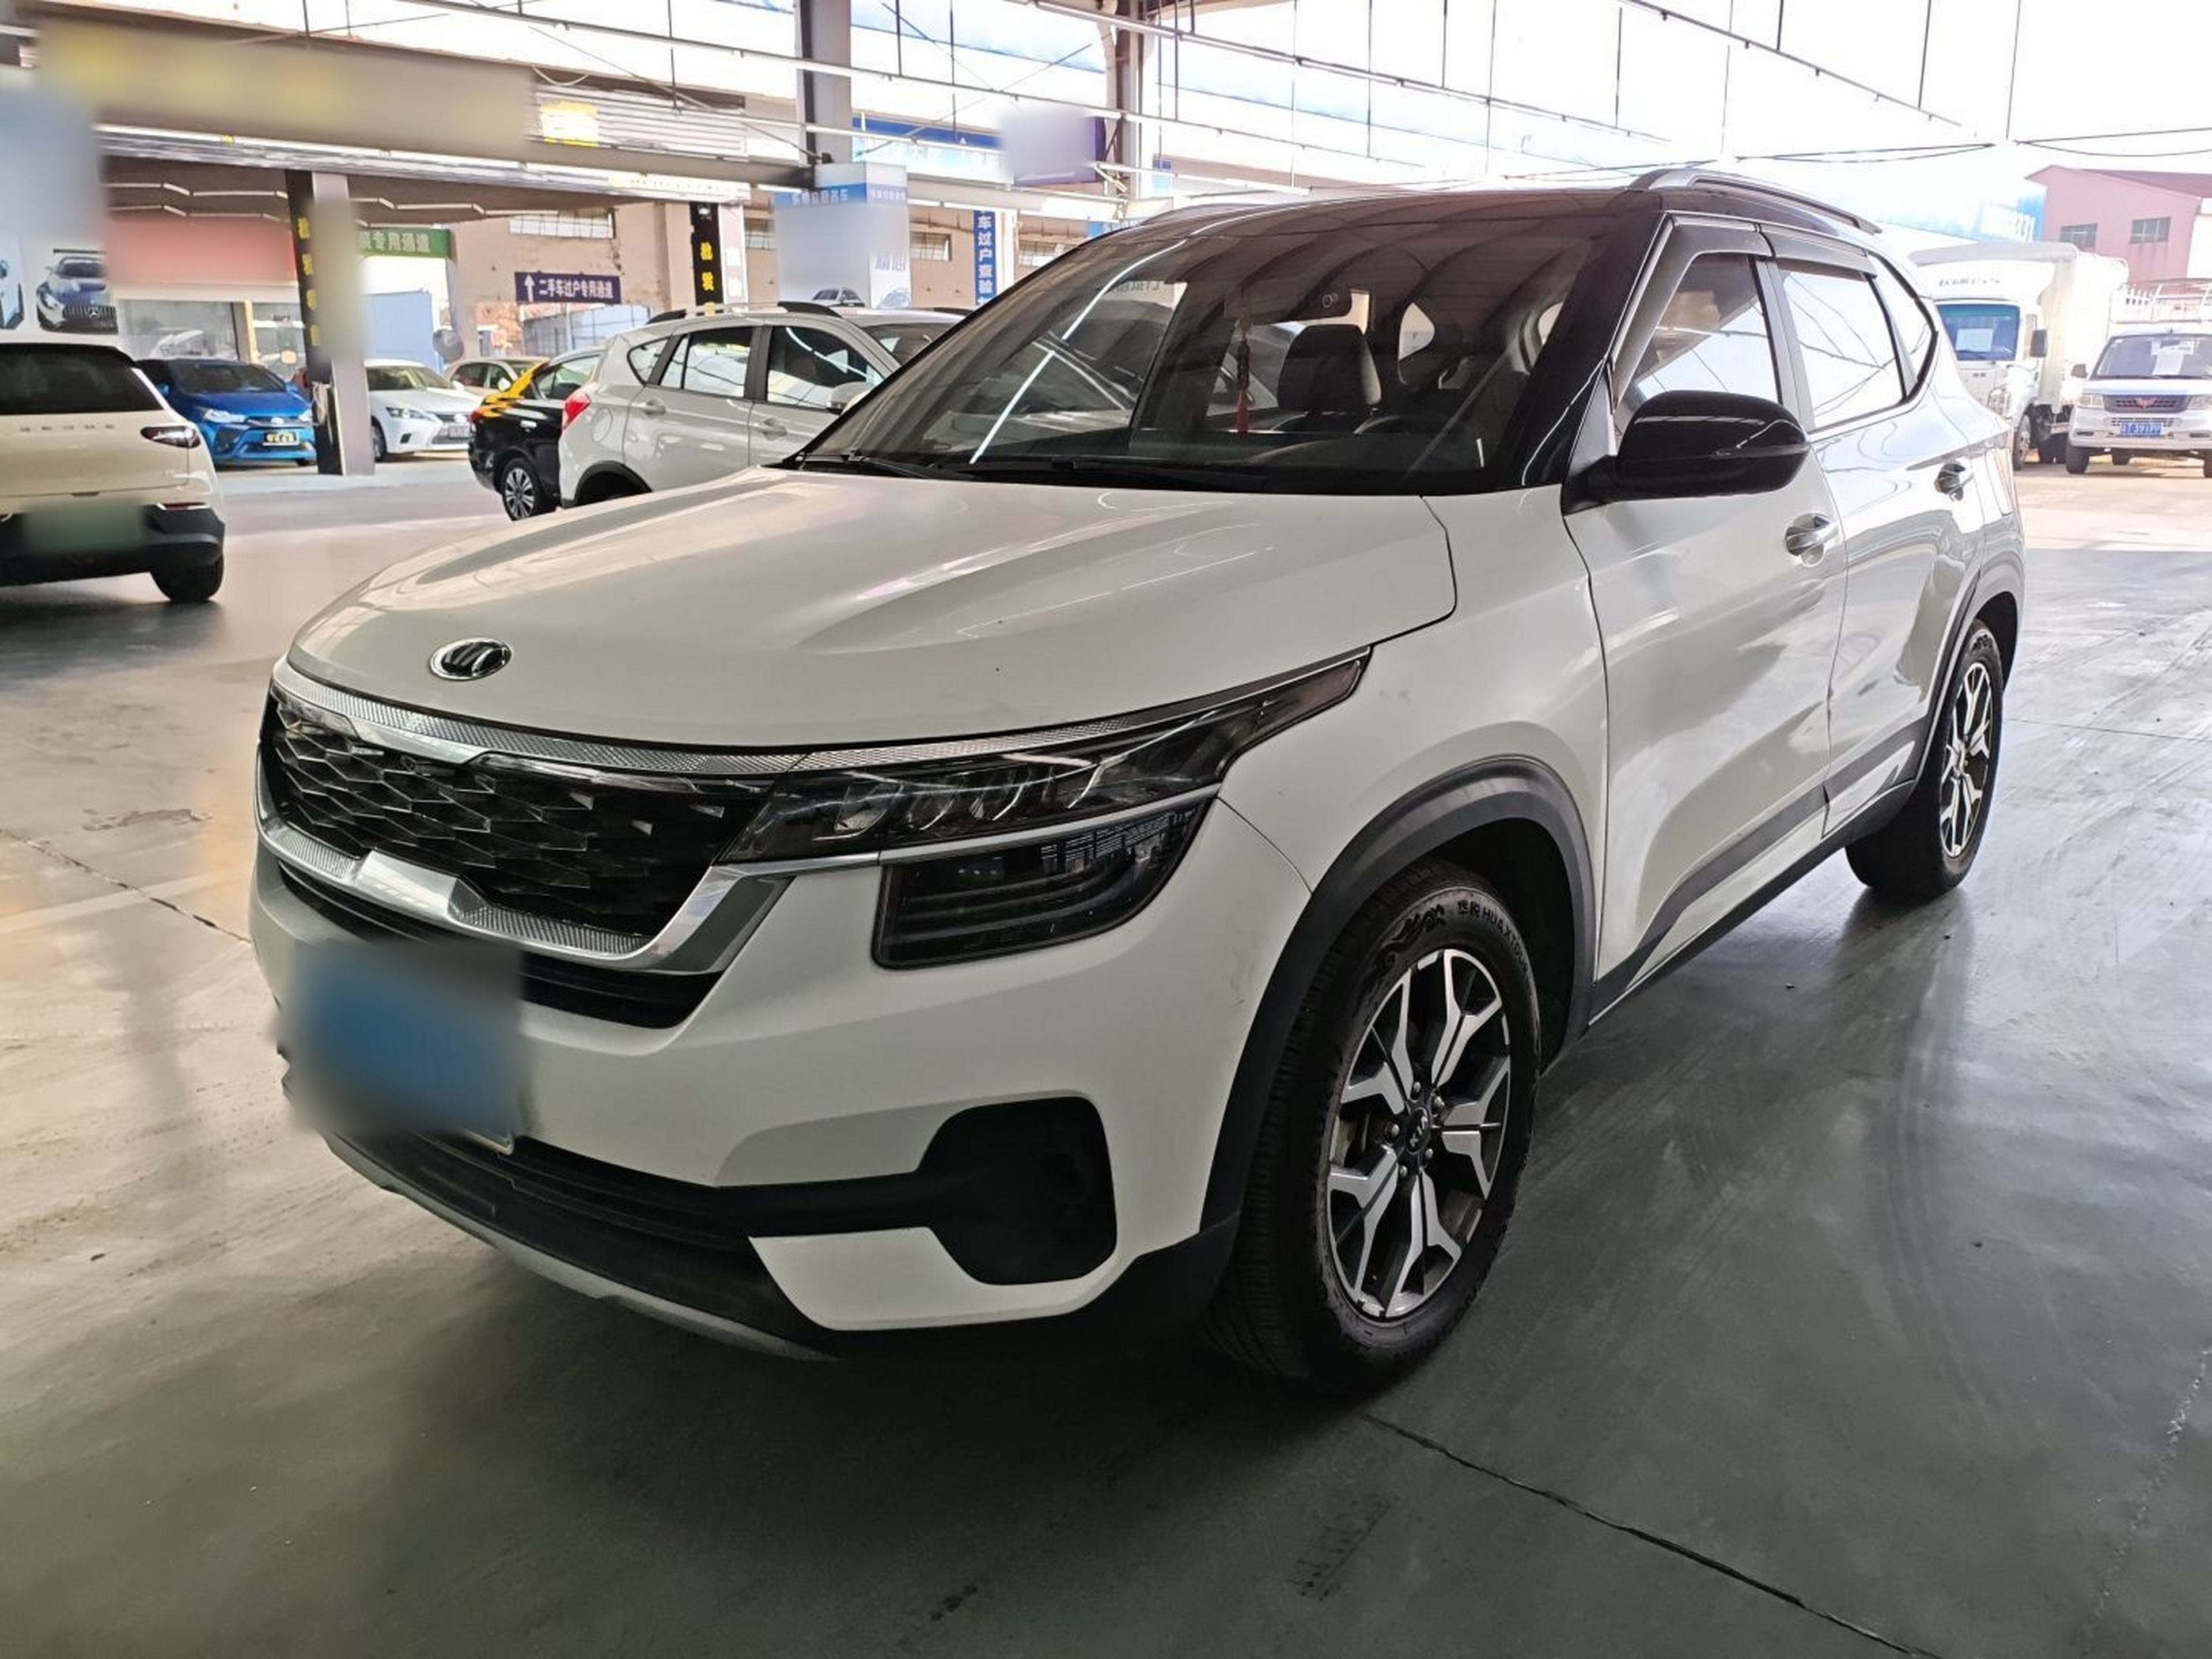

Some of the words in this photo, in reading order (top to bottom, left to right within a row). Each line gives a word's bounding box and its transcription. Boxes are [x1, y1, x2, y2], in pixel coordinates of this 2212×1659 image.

[539, 278, 614, 299] 二手车过户专用通道
